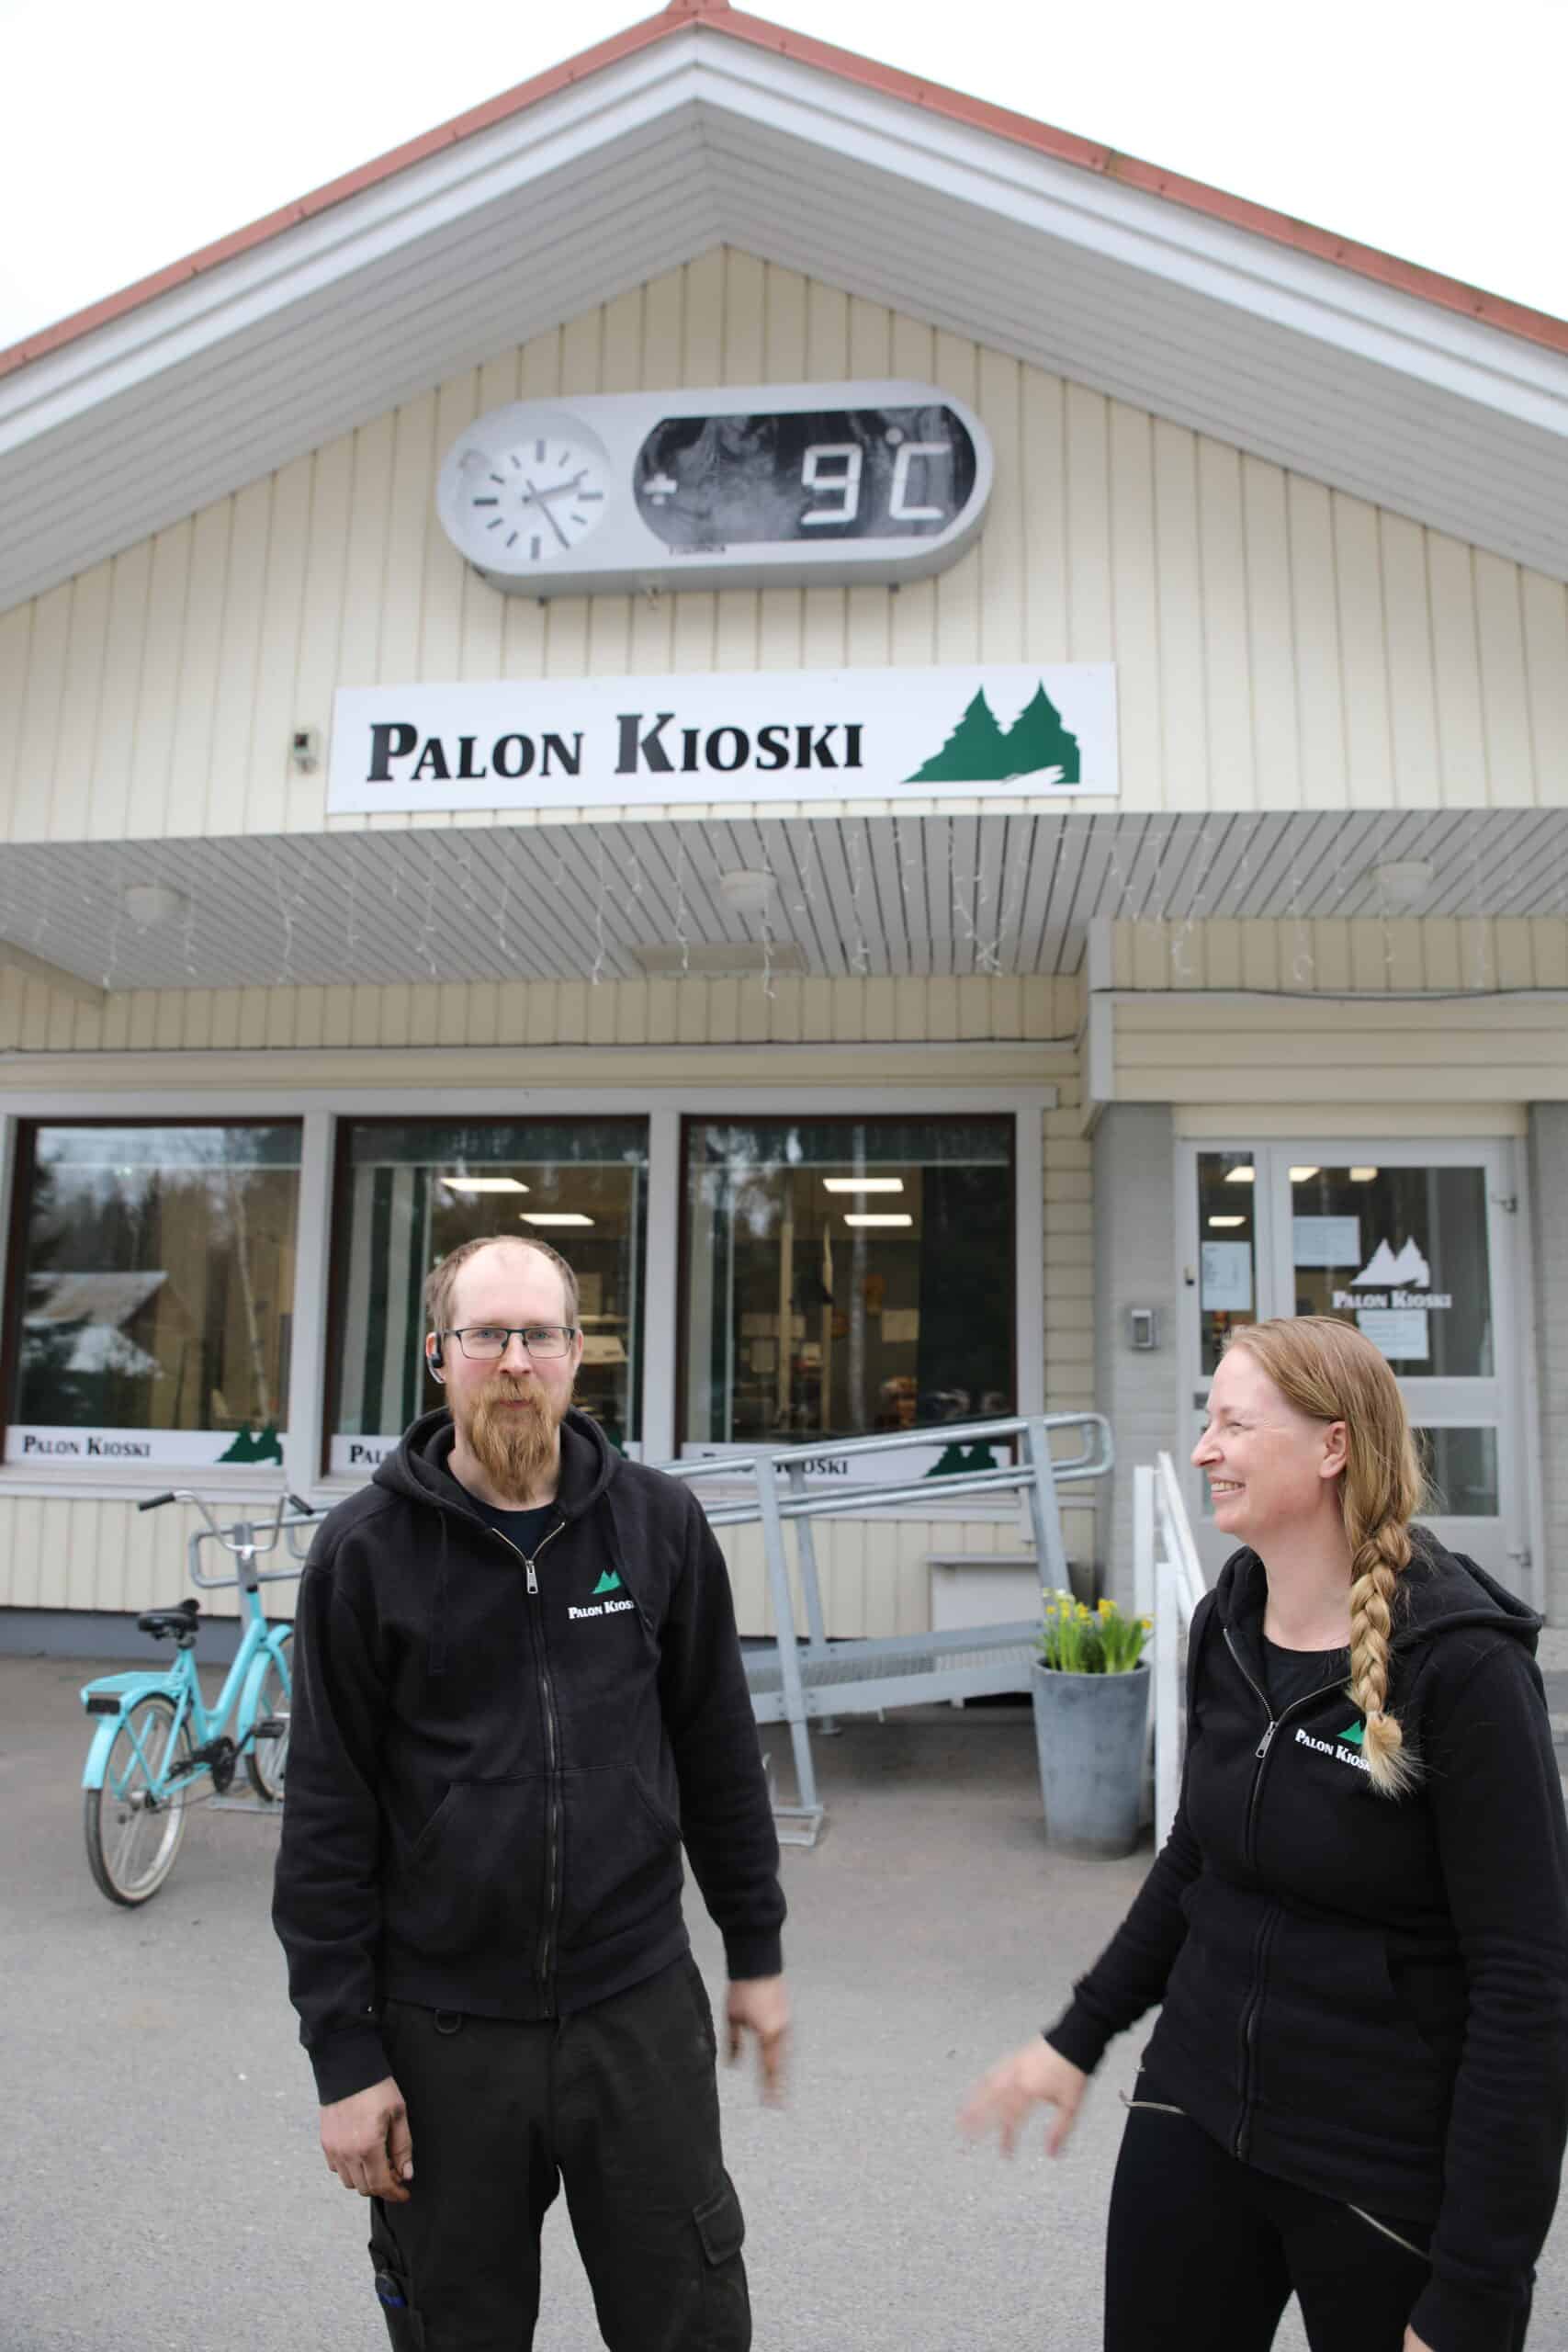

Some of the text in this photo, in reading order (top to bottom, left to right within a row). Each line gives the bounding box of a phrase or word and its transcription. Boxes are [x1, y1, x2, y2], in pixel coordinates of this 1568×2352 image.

[367, 711, 864, 784] PALON KIOSKI
[22, 1434, 152, 1458] PALON KIOSKI
[1295, 1728, 1334, 1755] PALON
